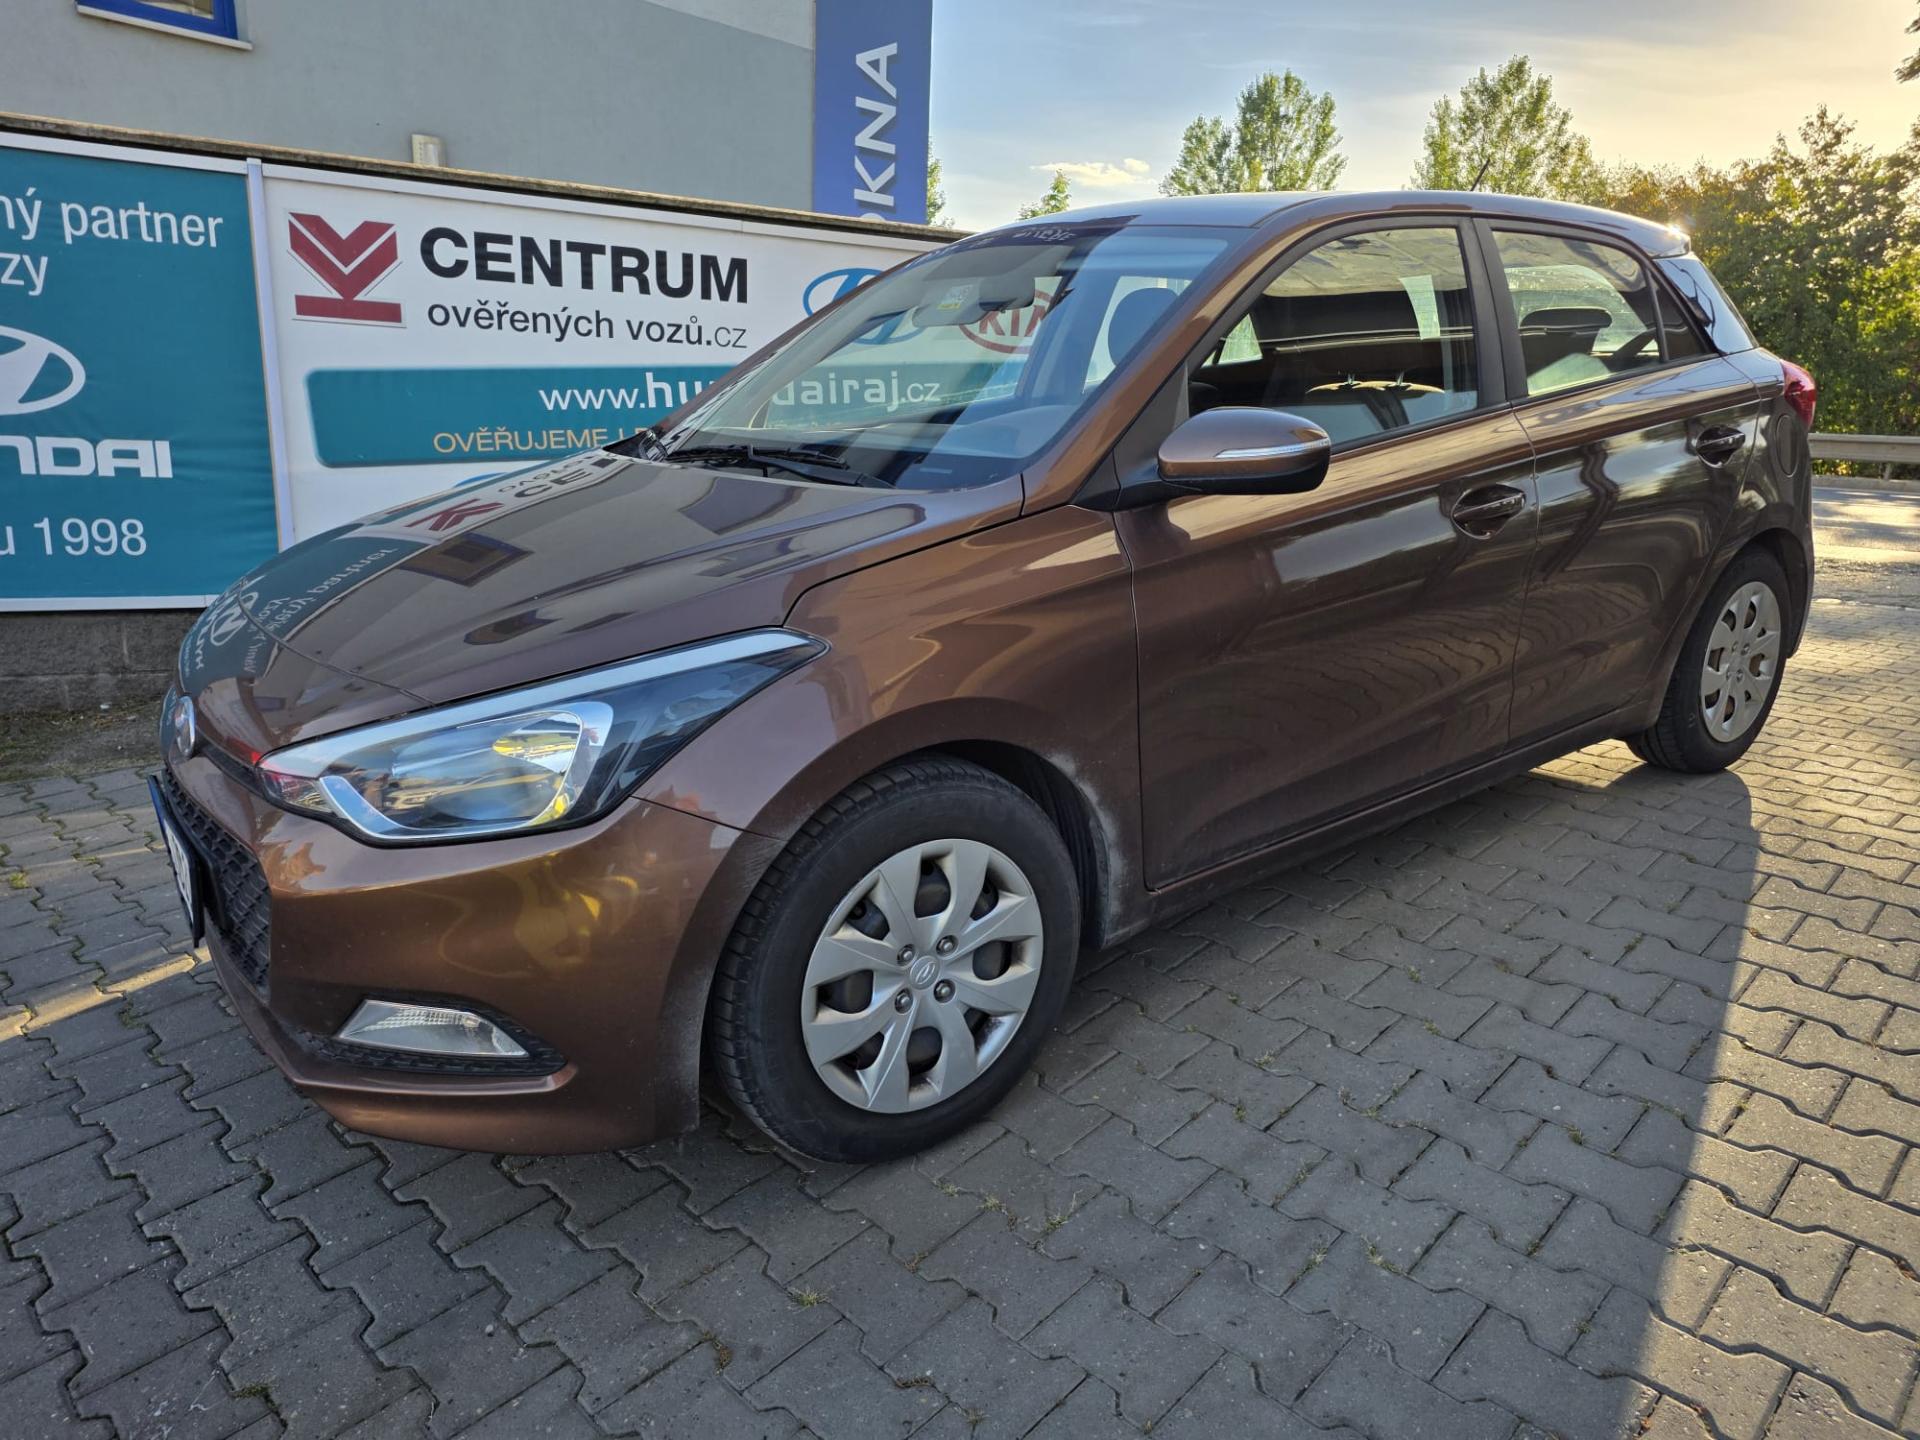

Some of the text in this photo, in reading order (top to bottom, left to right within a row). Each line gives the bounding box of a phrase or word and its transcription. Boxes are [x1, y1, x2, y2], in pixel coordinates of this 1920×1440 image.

[853, 42, 897, 221] KNA
[61, 201, 223, 248] partner
[420, 226, 748, 304] CENTRUM
[427, 299, 614, 342] ověřených
[433, 427, 608, 453] OVĚŘUJEME
[33, 517, 147, 556] 1998
